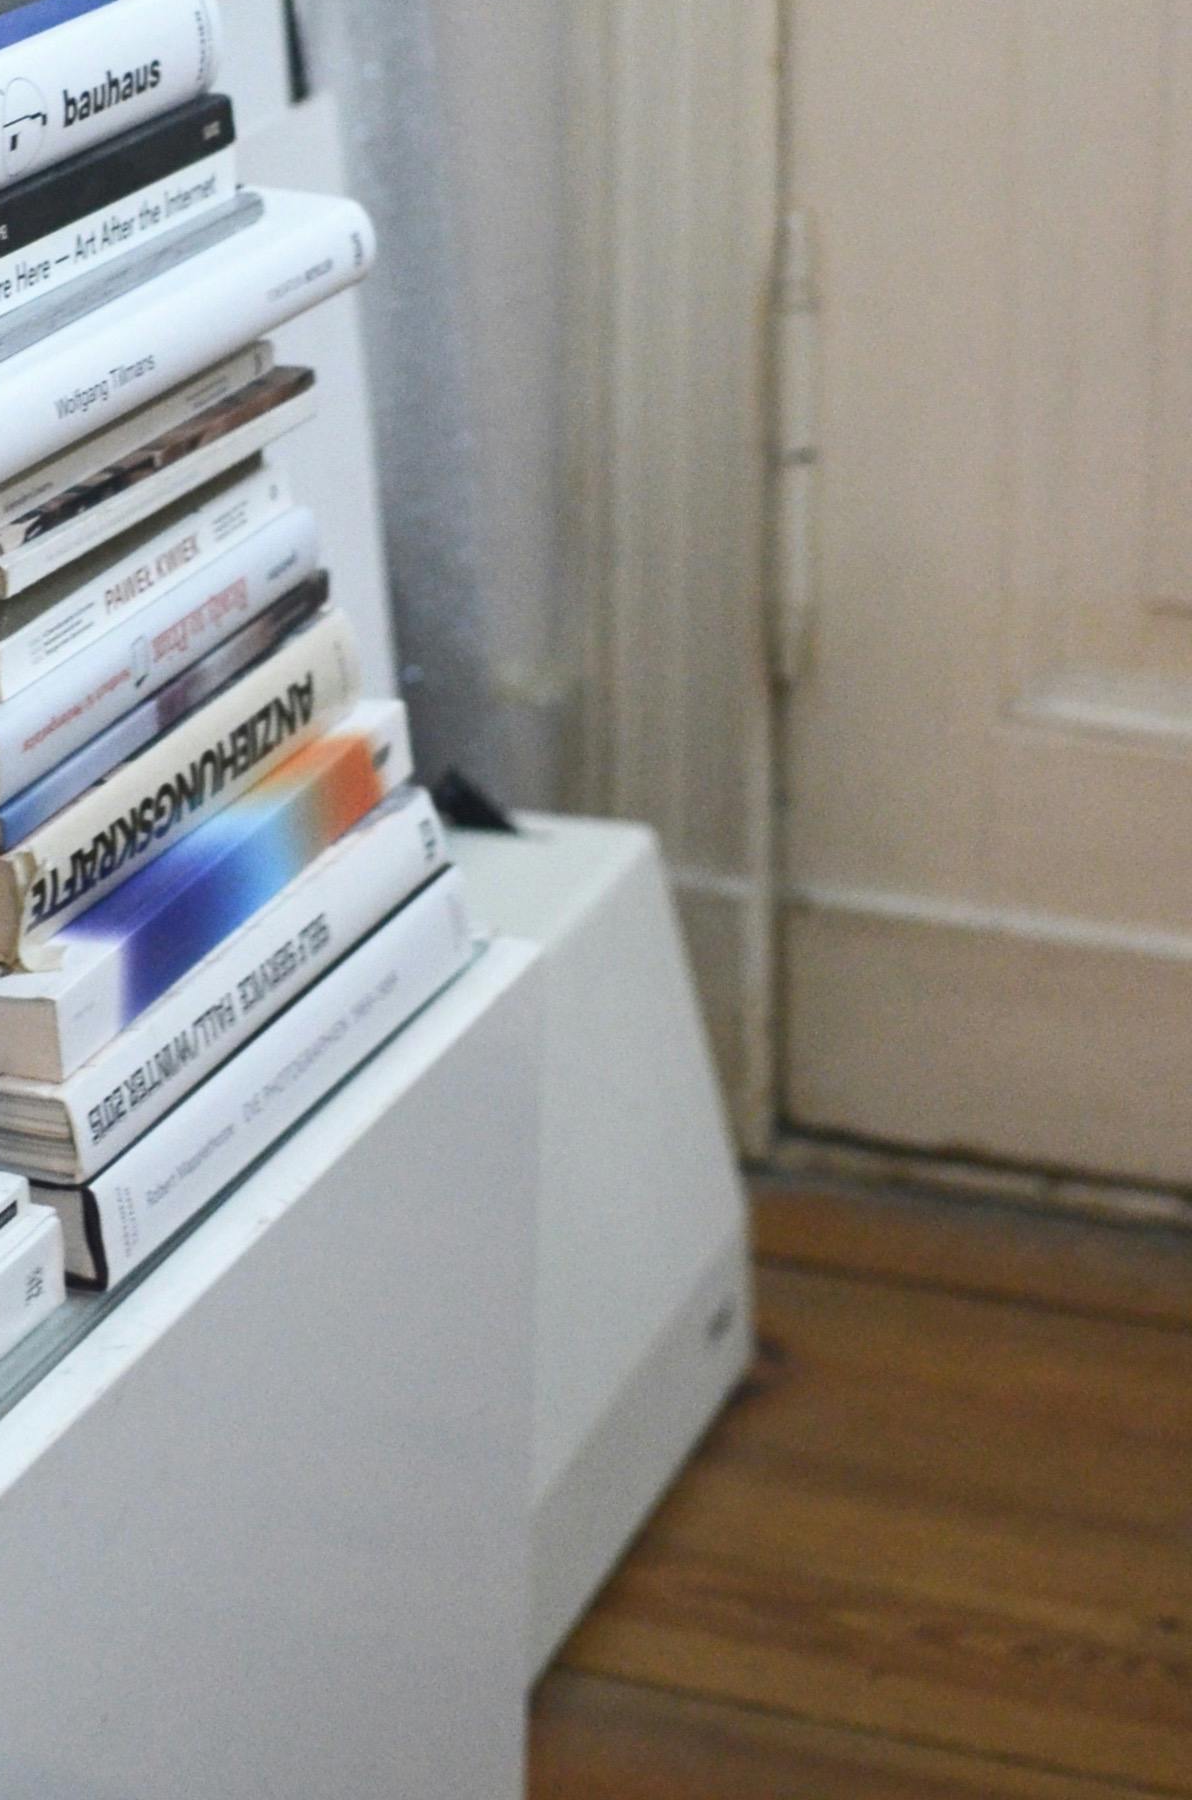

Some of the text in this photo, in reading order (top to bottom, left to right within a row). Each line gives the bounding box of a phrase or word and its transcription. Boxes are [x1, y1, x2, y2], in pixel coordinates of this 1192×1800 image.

[62, 59, 162, 128] bauhaus
[15, 260, 51, 292] Here
[74, 233, 97, 261] Art
[100, 214, 136, 254] After
[137, 200, 162, 231] the
[163, 173, 218, 220] Internet
[55, 378, 109, 420] Wolfgang
